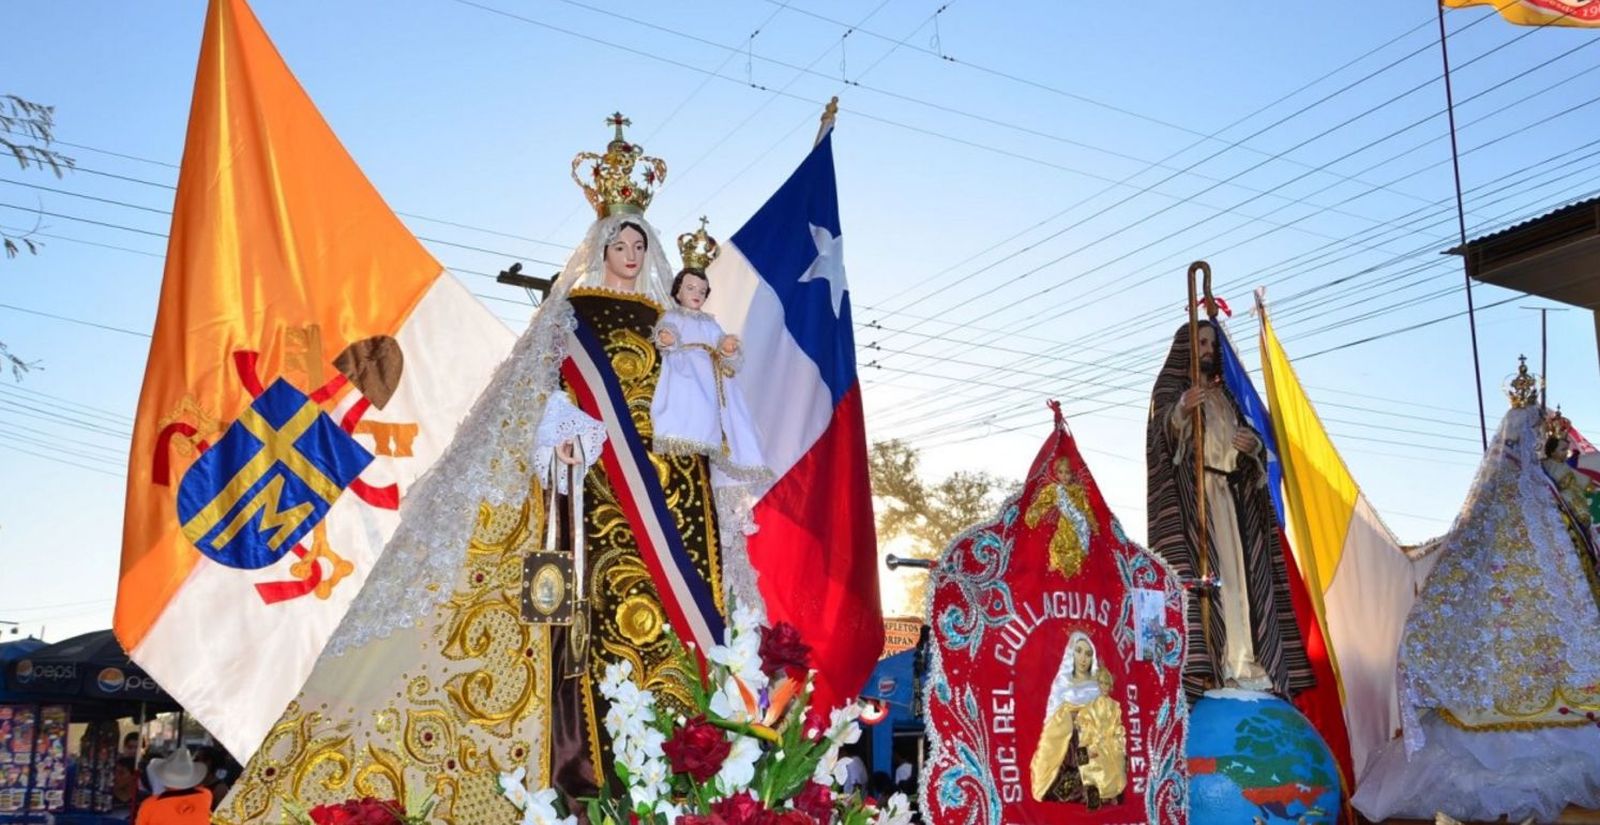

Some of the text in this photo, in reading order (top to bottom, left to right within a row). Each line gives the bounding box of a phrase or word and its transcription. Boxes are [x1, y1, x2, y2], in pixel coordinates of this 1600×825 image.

[1583, 4, 1600, 17] 19
[994, 591, 1111, 667] CULLAGUAS
[1112, 616, 1134, 674] DEL
[32, 663, 77, 681] pepsi
